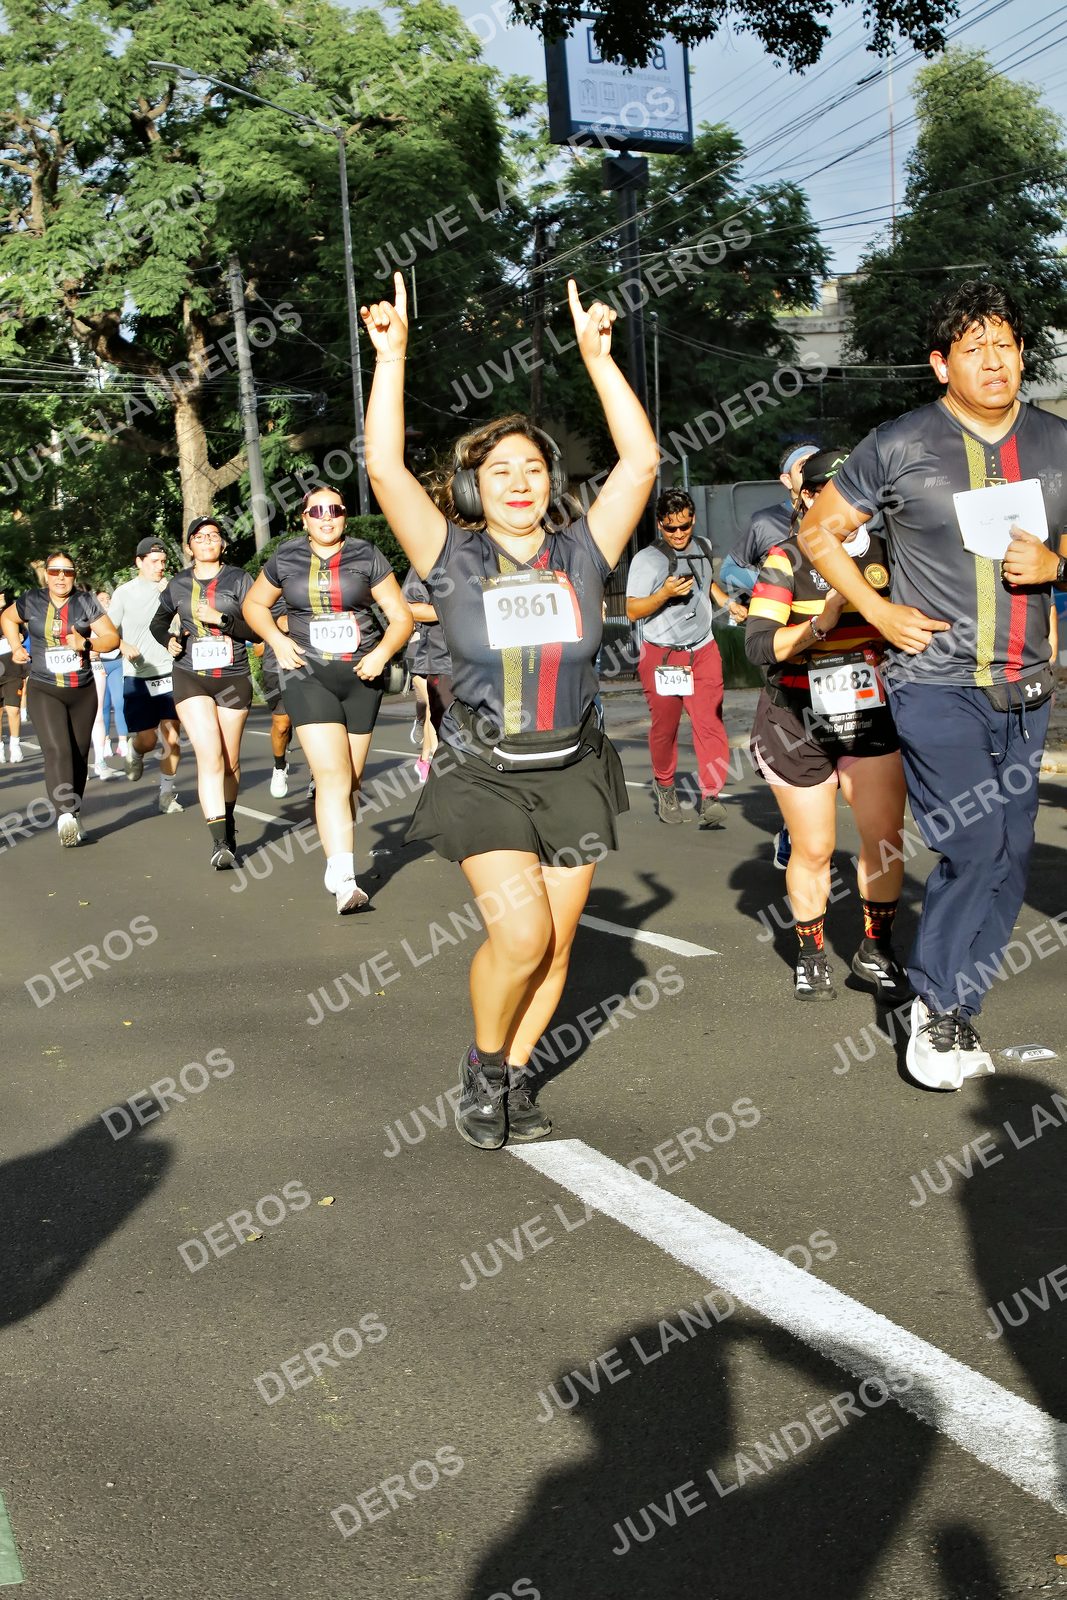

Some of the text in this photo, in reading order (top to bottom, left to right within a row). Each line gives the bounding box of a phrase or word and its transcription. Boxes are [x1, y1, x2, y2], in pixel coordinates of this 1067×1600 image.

[643, 129, 652, 137] 33
[497, 592, 559, 621] 9861
[313, 625, 354, 640] 10570
[813, 669, 873, 695] 10282
[834, 723, 844, 734] Soy
